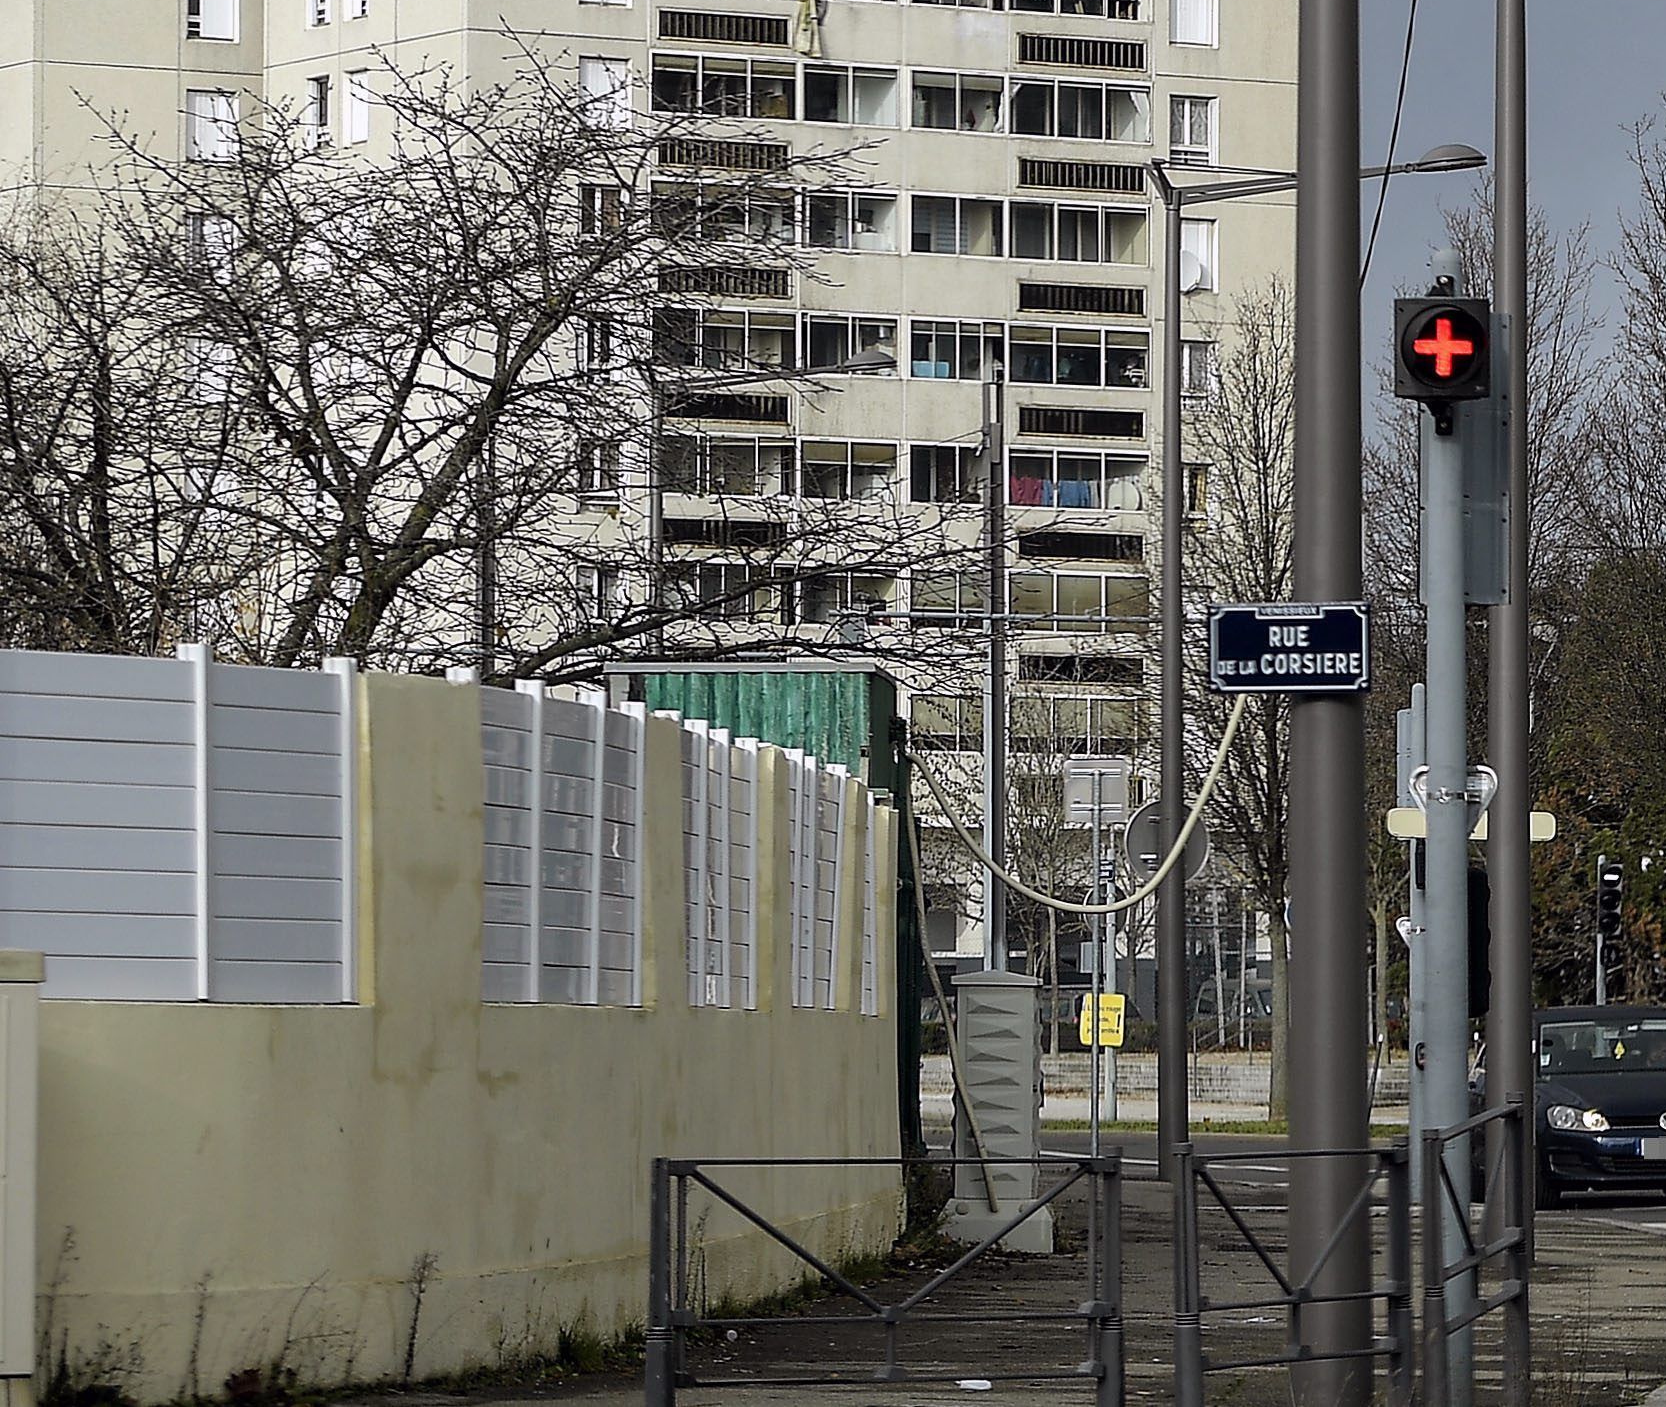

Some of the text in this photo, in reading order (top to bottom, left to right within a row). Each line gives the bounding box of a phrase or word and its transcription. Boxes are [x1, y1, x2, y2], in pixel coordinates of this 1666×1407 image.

[1268, 626, 1310, 647] RUE
[1217, 652, 1361, 675] DE LA CORSIERE
